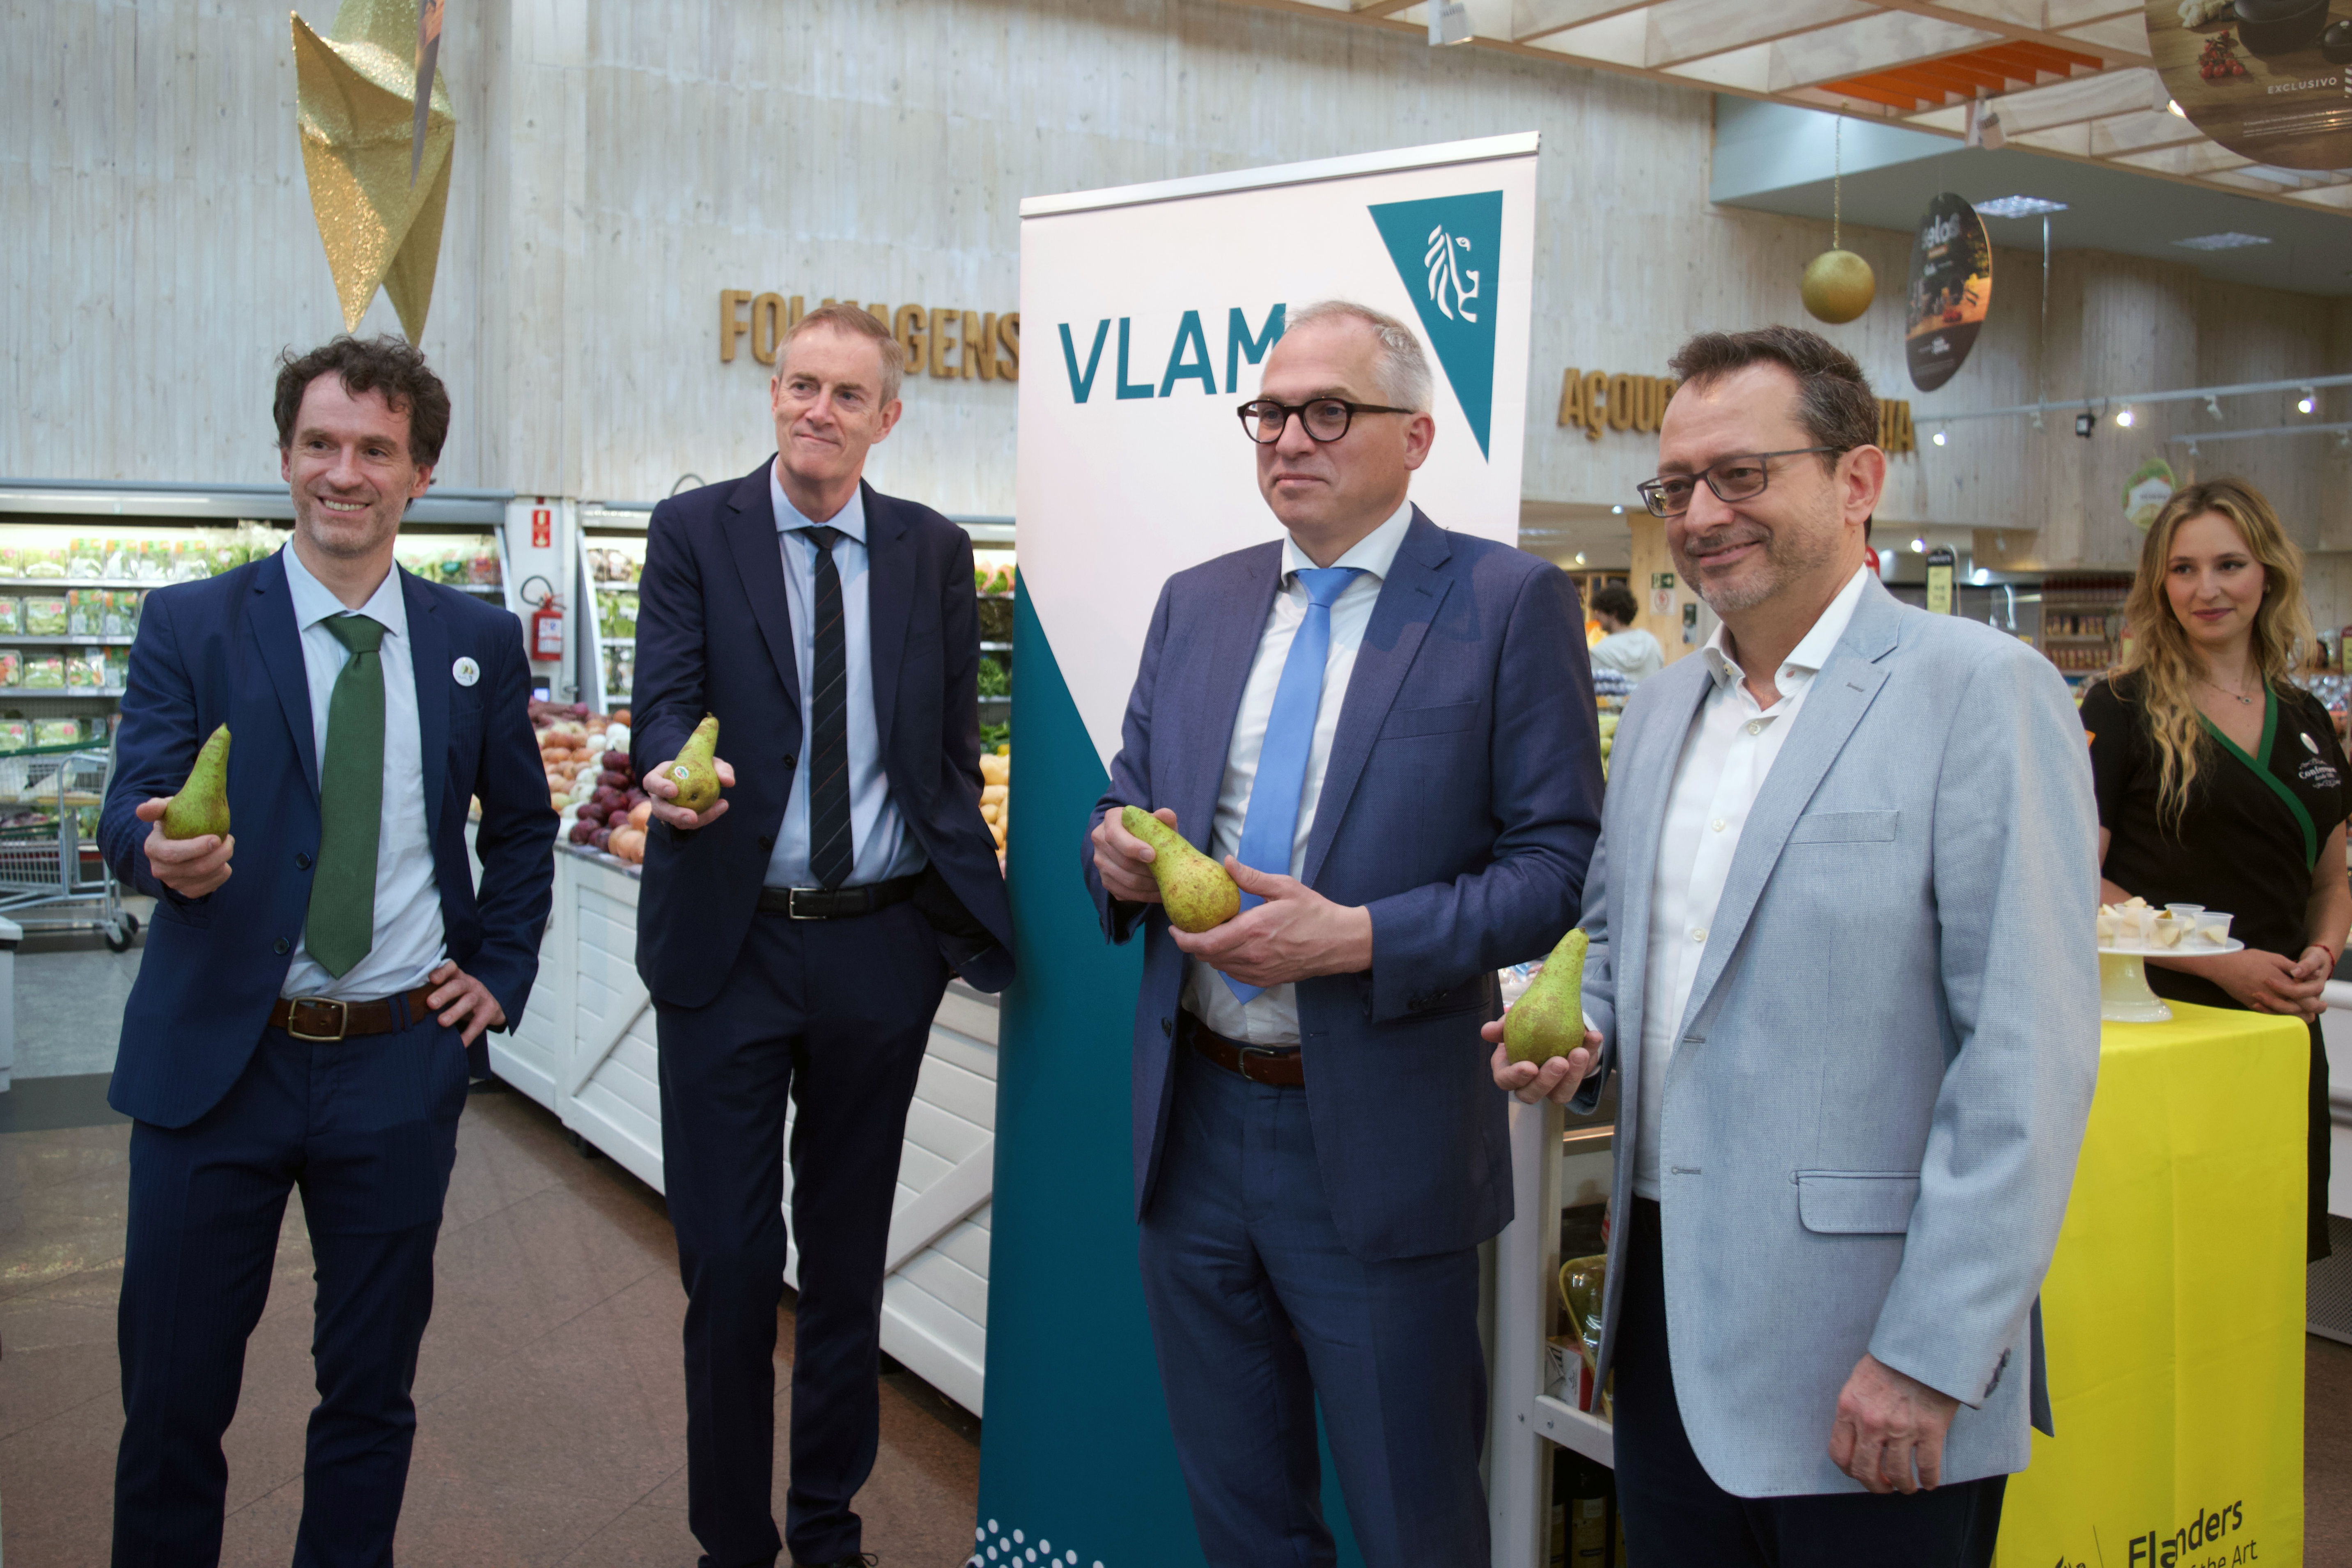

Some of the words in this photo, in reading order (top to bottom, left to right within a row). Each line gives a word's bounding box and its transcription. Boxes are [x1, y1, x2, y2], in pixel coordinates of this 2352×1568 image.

[2267, 77, 2337, 94] EXCLUSIVO
[719, 289, 1020, 382] FOGENS
[1058, 303, 1286, 404] VLAM
[2128, 1500, 2242, 1568] Flanders
[2232, 1540, 2258, 1568] Art
